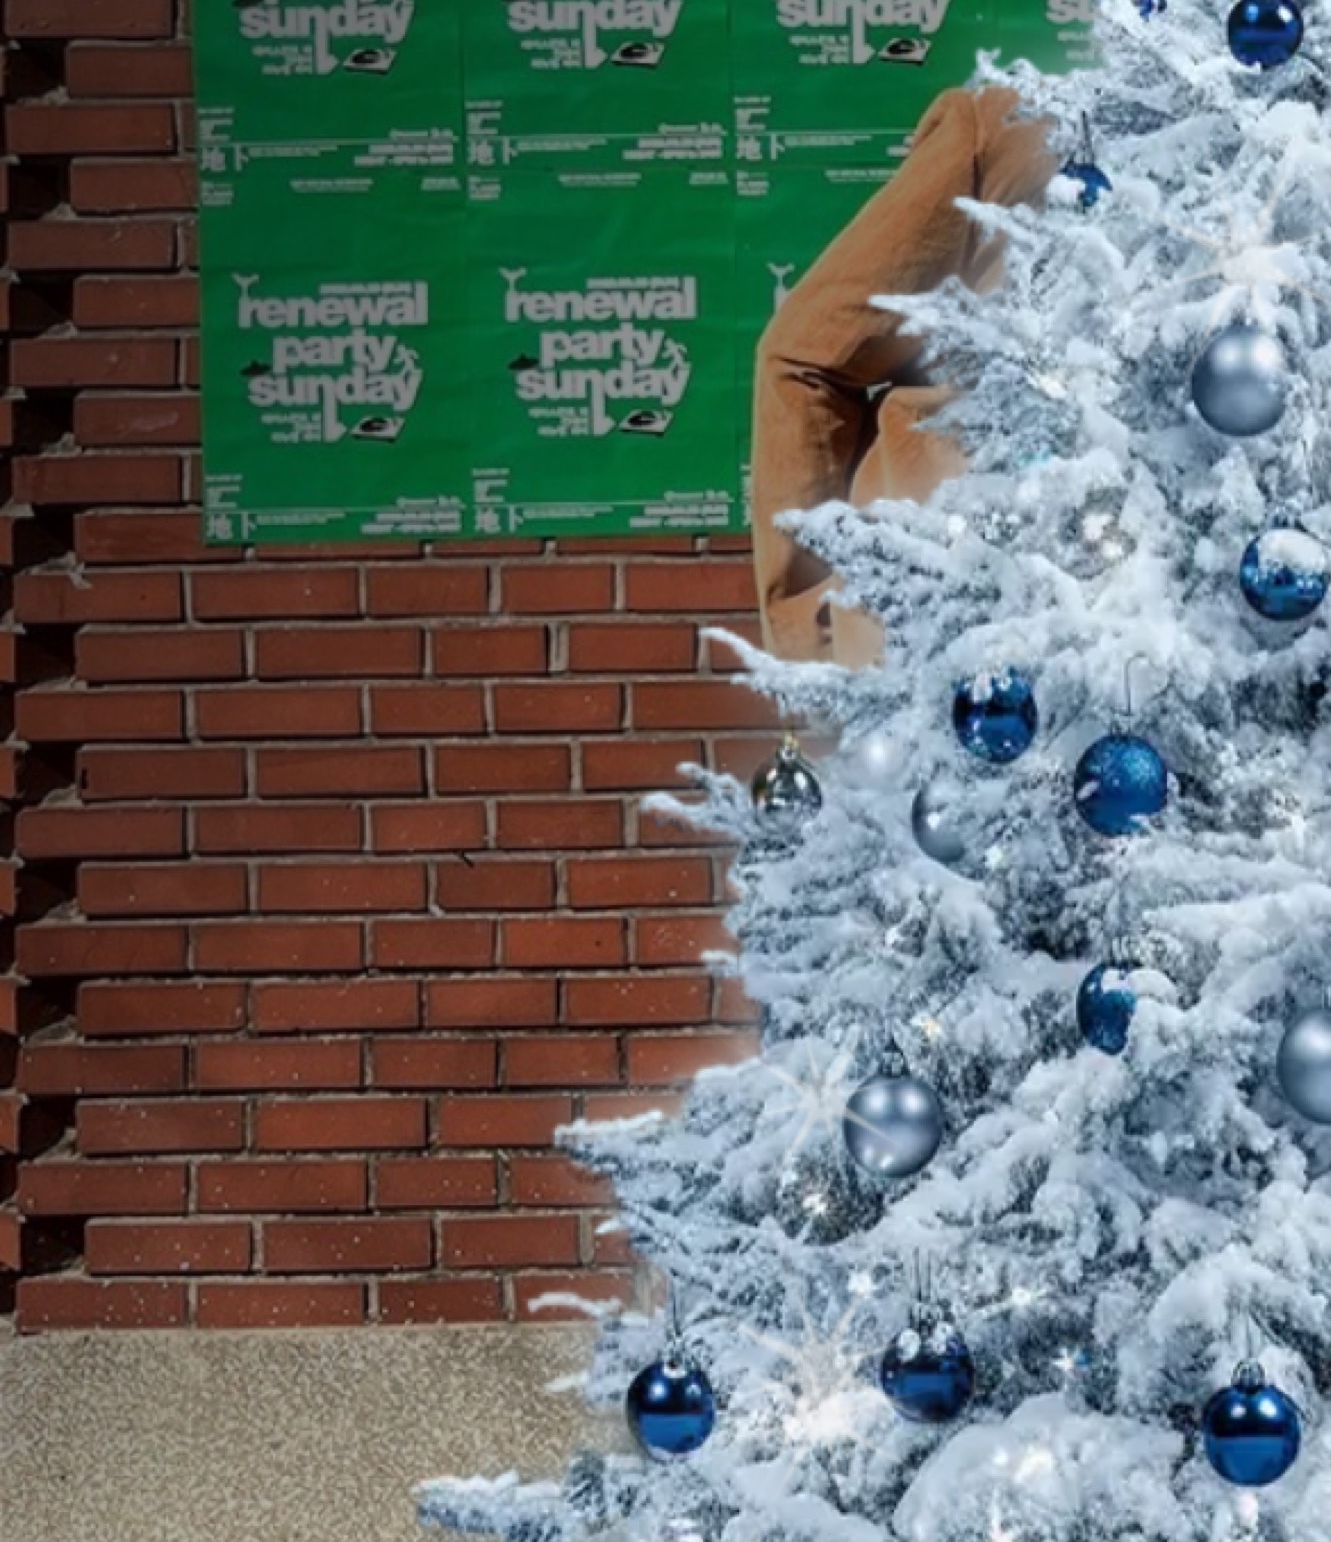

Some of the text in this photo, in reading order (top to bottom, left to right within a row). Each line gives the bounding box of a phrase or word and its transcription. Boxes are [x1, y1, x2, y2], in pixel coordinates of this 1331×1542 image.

[239, 283, 427, 326] renewal
[506, 277, 695, 320] renewal
[273, 329, 396, 372] party
[541, 323, 665, 367] party
[248, 365, 423, 442] sunday
[516, 359, 692, 436] sunday
